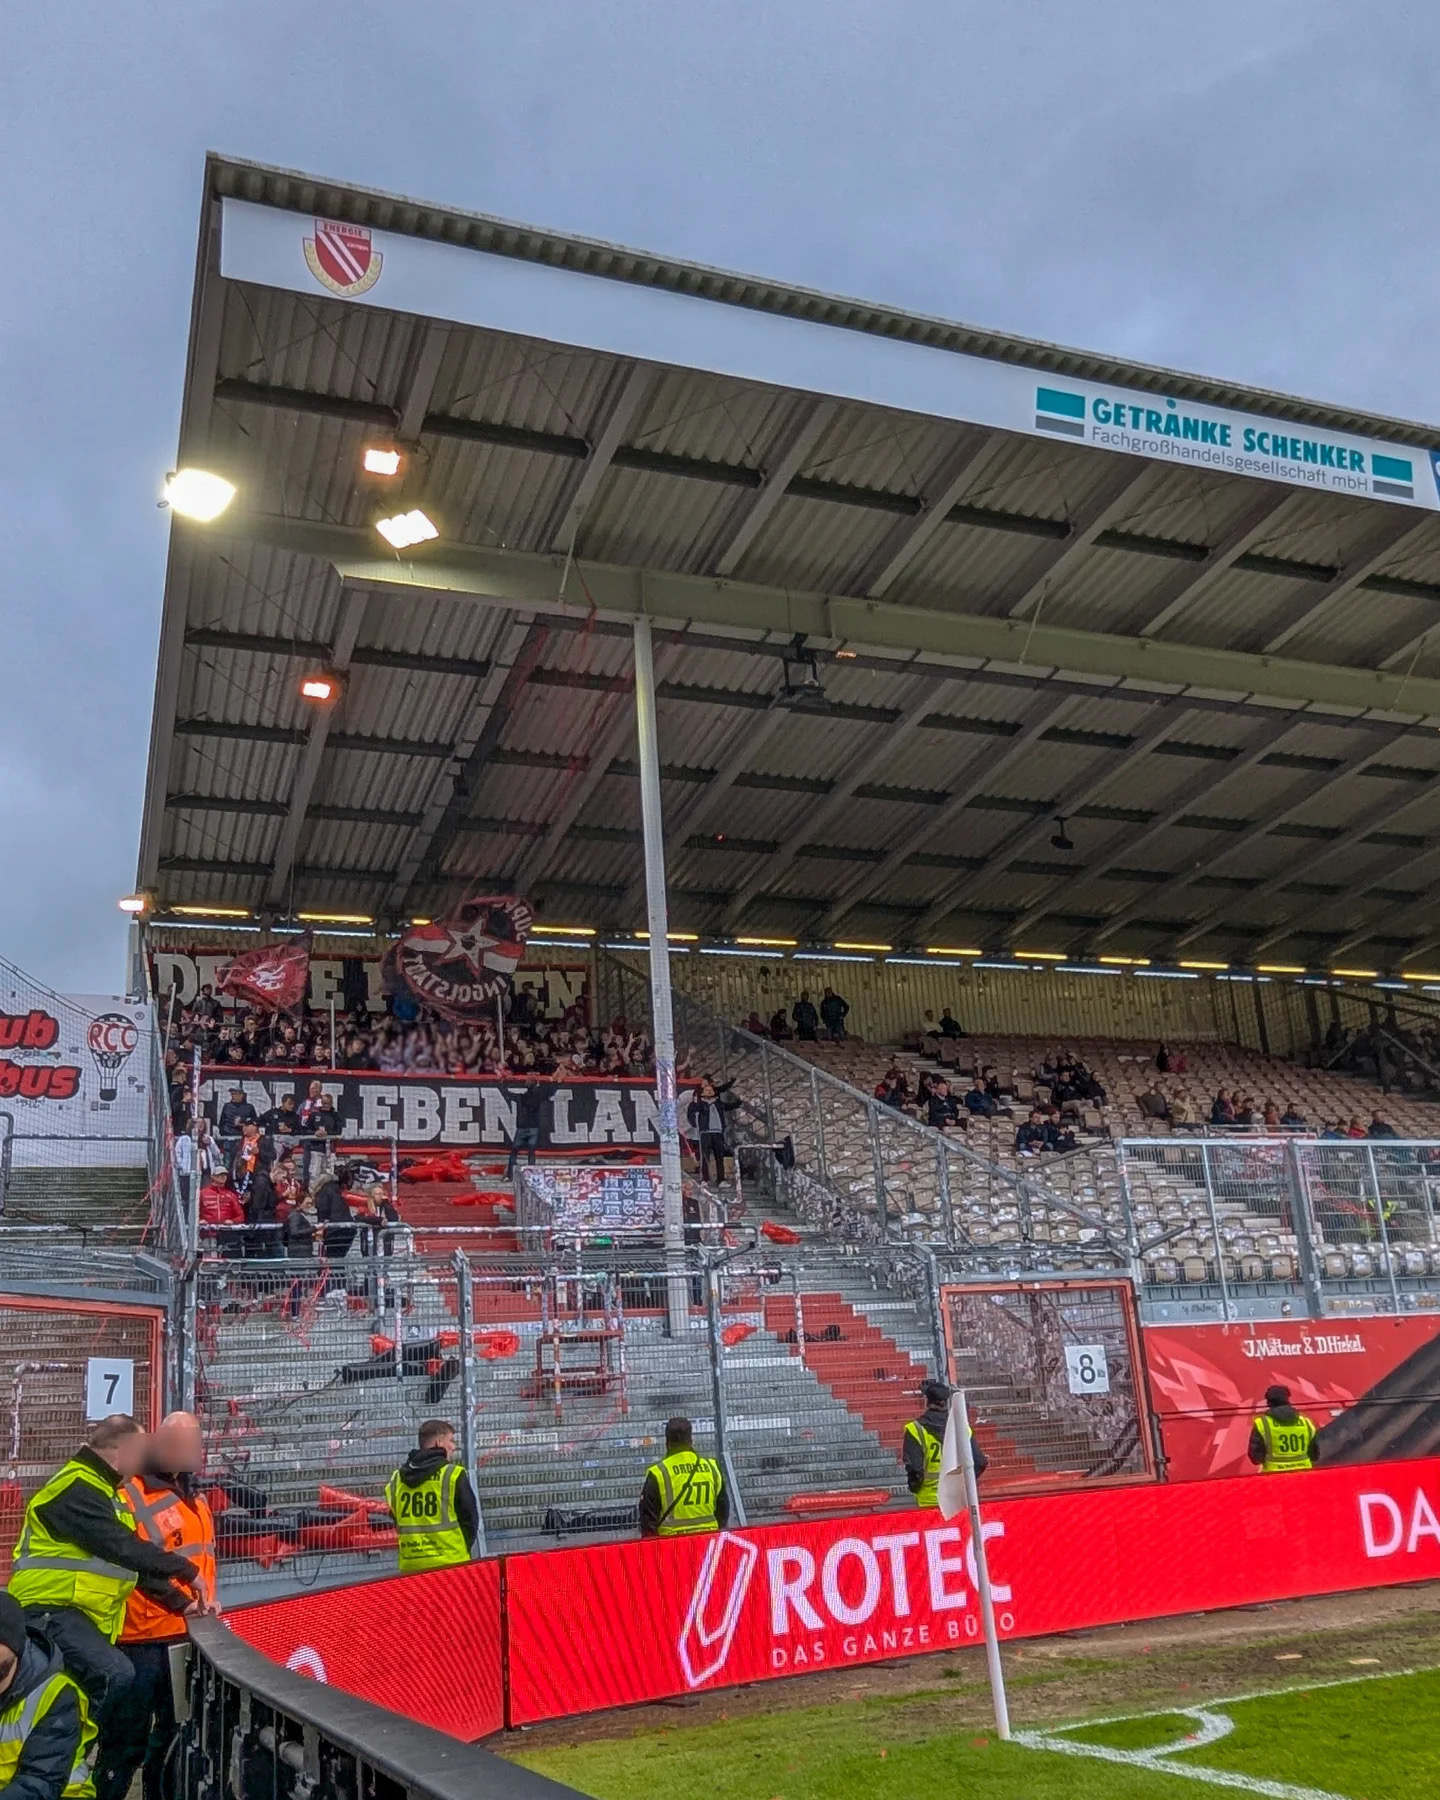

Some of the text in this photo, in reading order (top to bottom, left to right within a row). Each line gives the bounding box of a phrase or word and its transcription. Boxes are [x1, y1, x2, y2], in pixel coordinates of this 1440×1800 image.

[1091, 425, 1368, 492] Fachgroßhandelsgesellschaft mbH
[1243, 427, 1367, 474] SCHENKER
[88, 1022, 139, 1053] RCC
[1079, 1353, 1096, 1384] 8
[103, 1373, 120, 1405] 7
[1279, 1433, 1305, 1453] 301
[400, 1491, 438, 1519] 268
[683, 1480, 711, 1506] 277
[171, 1527, 183, 1548] 3
[1359, 1486, 1440, 1558] DA
[766, 1520, 1012, 1637] ROTEC
[772, 1611, 1015, 1669] DAS GANZE BÜO
